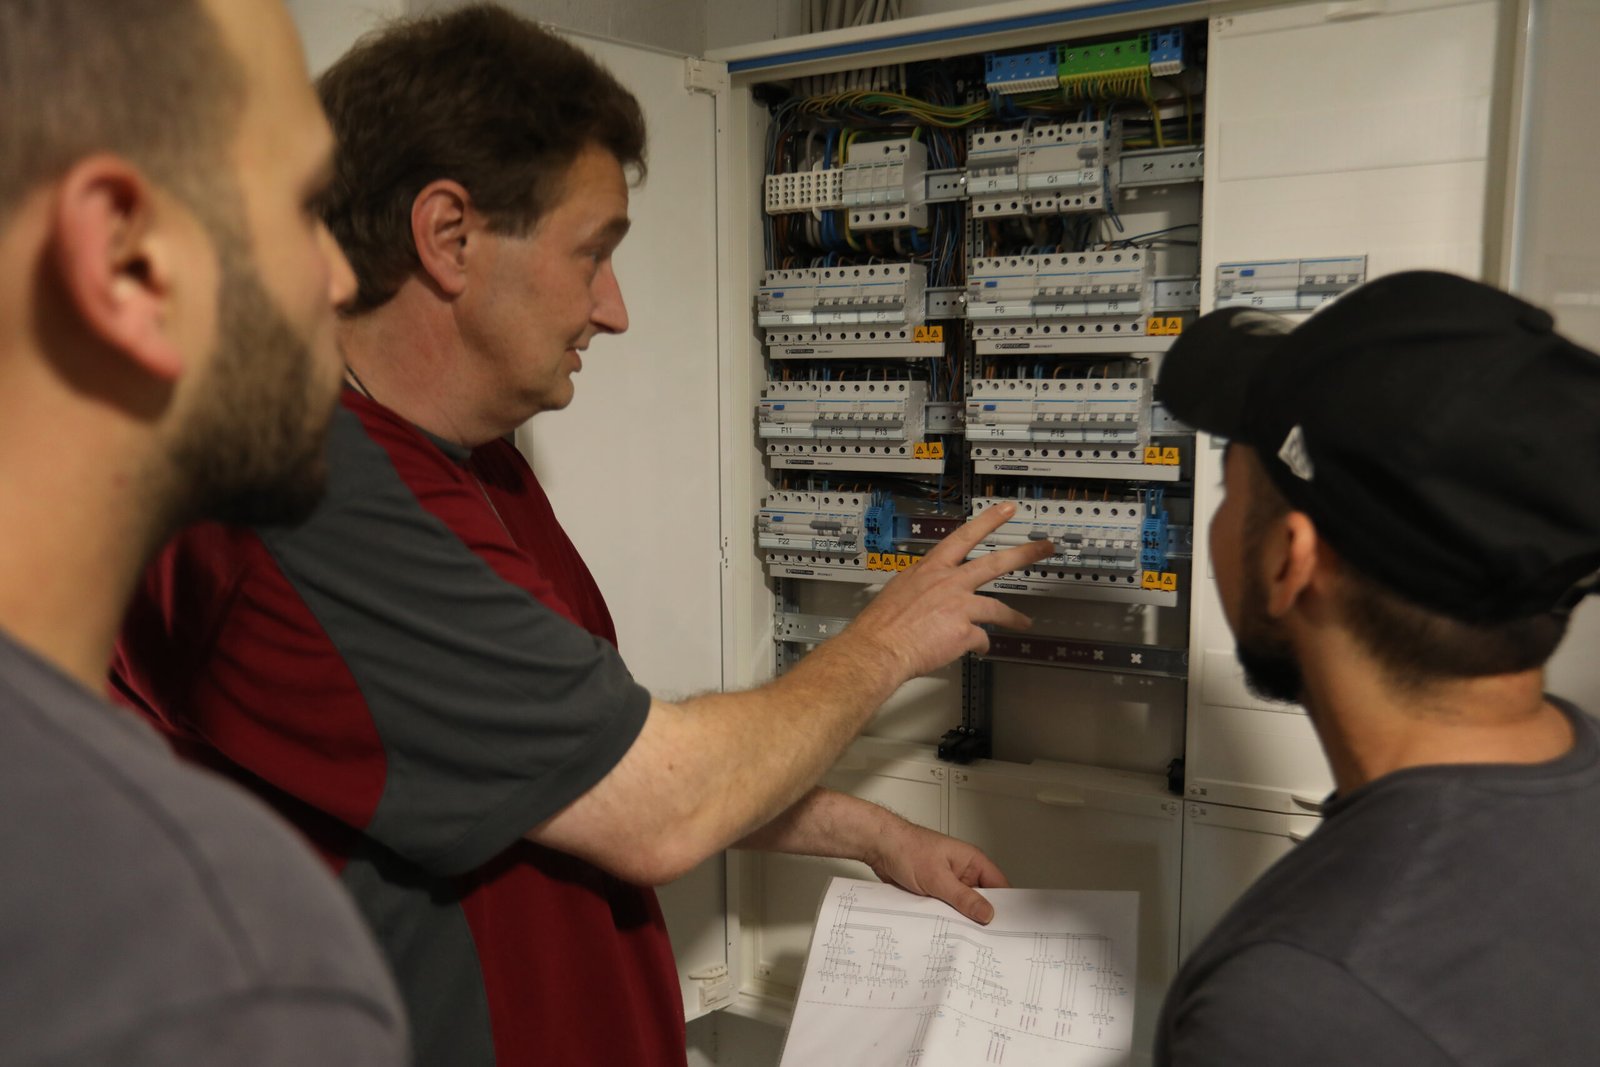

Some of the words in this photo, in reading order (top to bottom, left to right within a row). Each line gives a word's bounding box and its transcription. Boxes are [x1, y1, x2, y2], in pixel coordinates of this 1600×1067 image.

[1047, 175, 1058, 184] Q1
[1083, 171, 1094, 180] F2
[989, 180, 997, 188] F1
[781, 314, 790, 322] F3
[781, 426, 792, 434] F11
[831, 427, 843, 435] F12
[875, 427, 888, 436] F13
[991, 428, 1004, 436] F14
